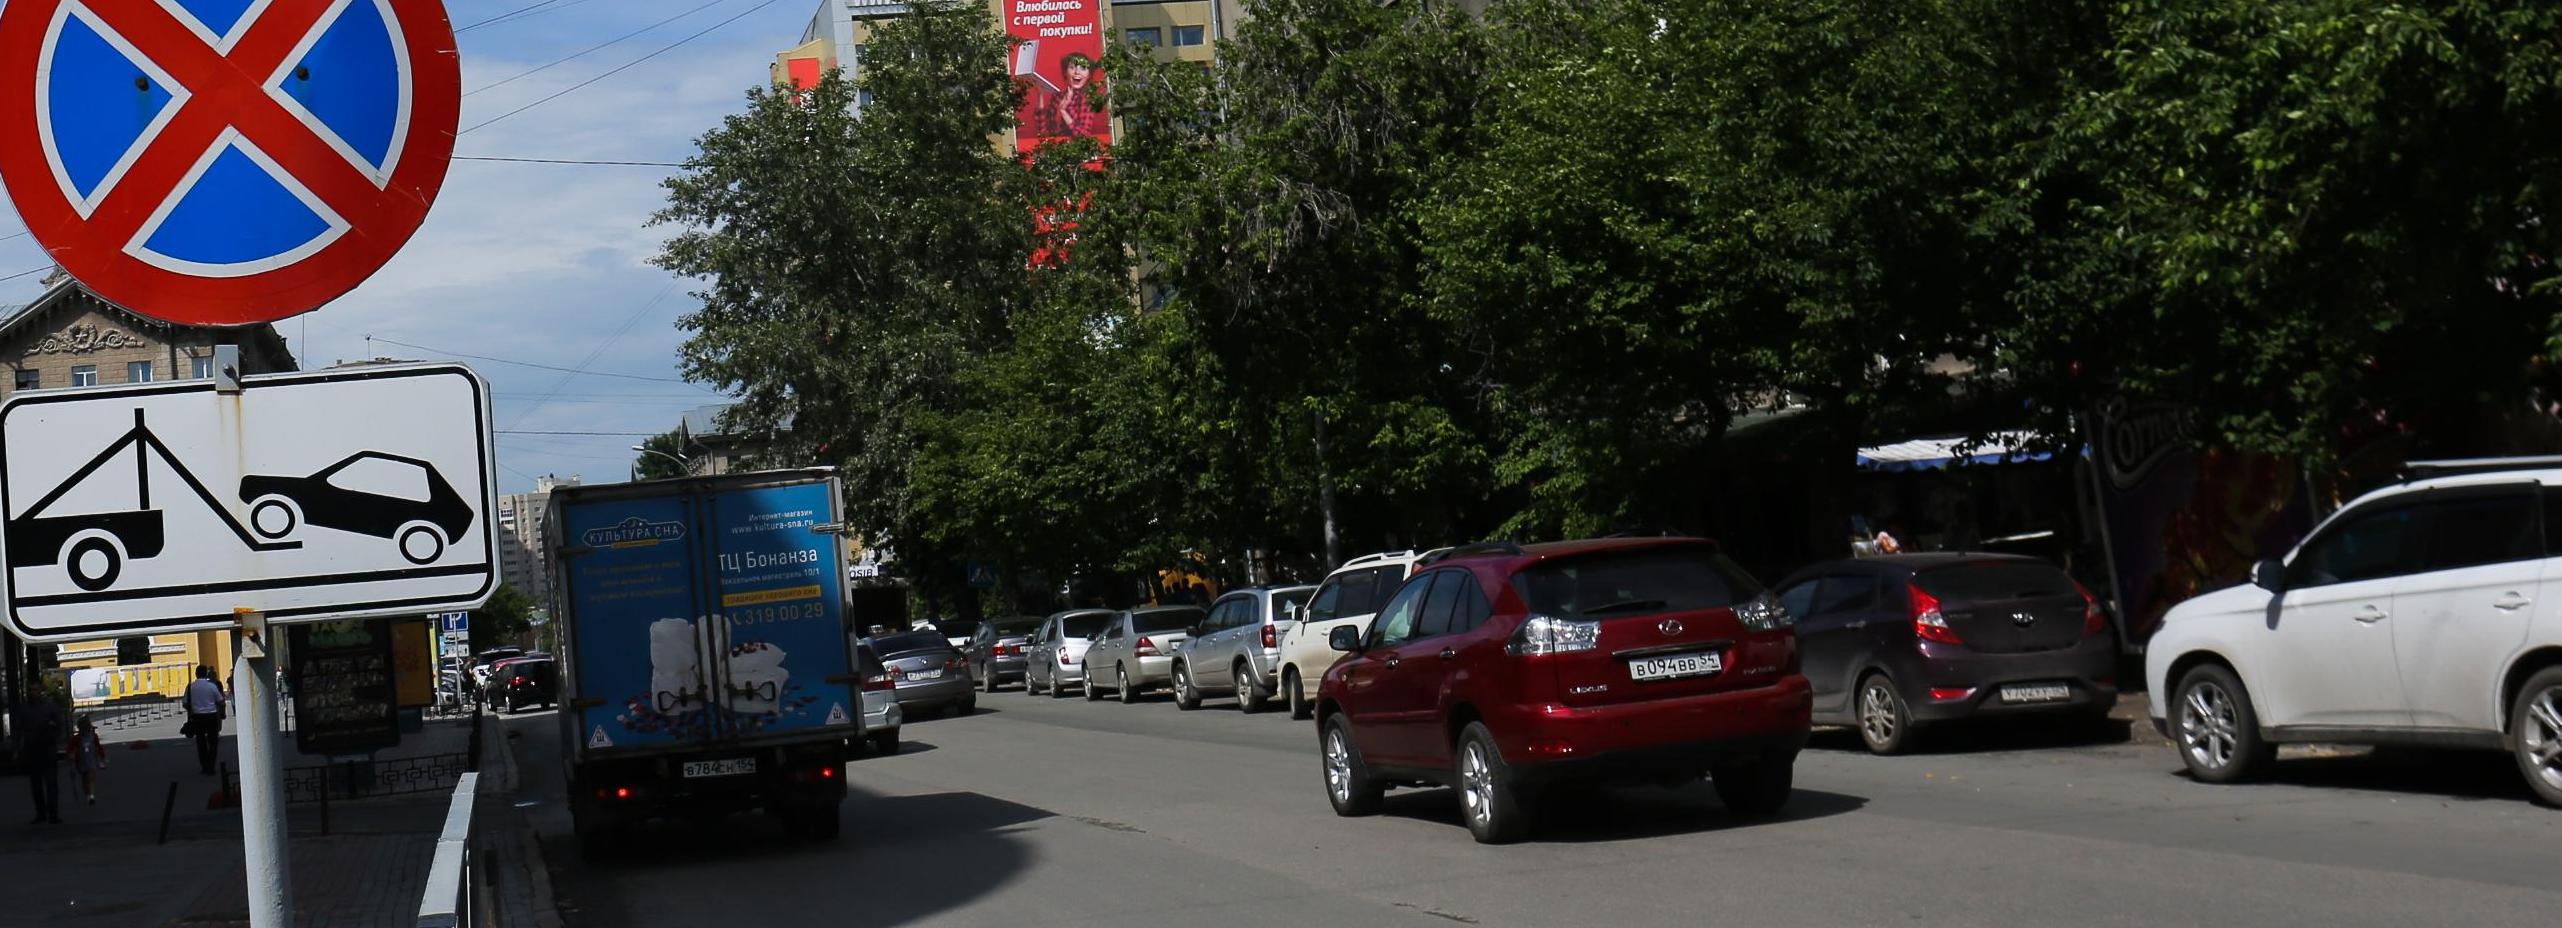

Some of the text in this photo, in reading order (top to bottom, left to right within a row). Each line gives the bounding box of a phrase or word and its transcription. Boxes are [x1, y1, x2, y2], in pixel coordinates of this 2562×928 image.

[1016, 0, 1082, 13] Влюбилась
[1013, 12, 1065, 27] с первой
[1040, 23, 1093, 39] покупки!
[748, 510, 813, 522] Интернет-магазин
[732, 519, 814, 534] www.kultura-sna.ru
[589, 525, 679, 544] КУЛЬТУРА СНА
[719, 549, 818, 573] ТЦ Бонанза
[804, 568, 819, 577] 10/1
[745, 603, 824, 625] 319 00 29
